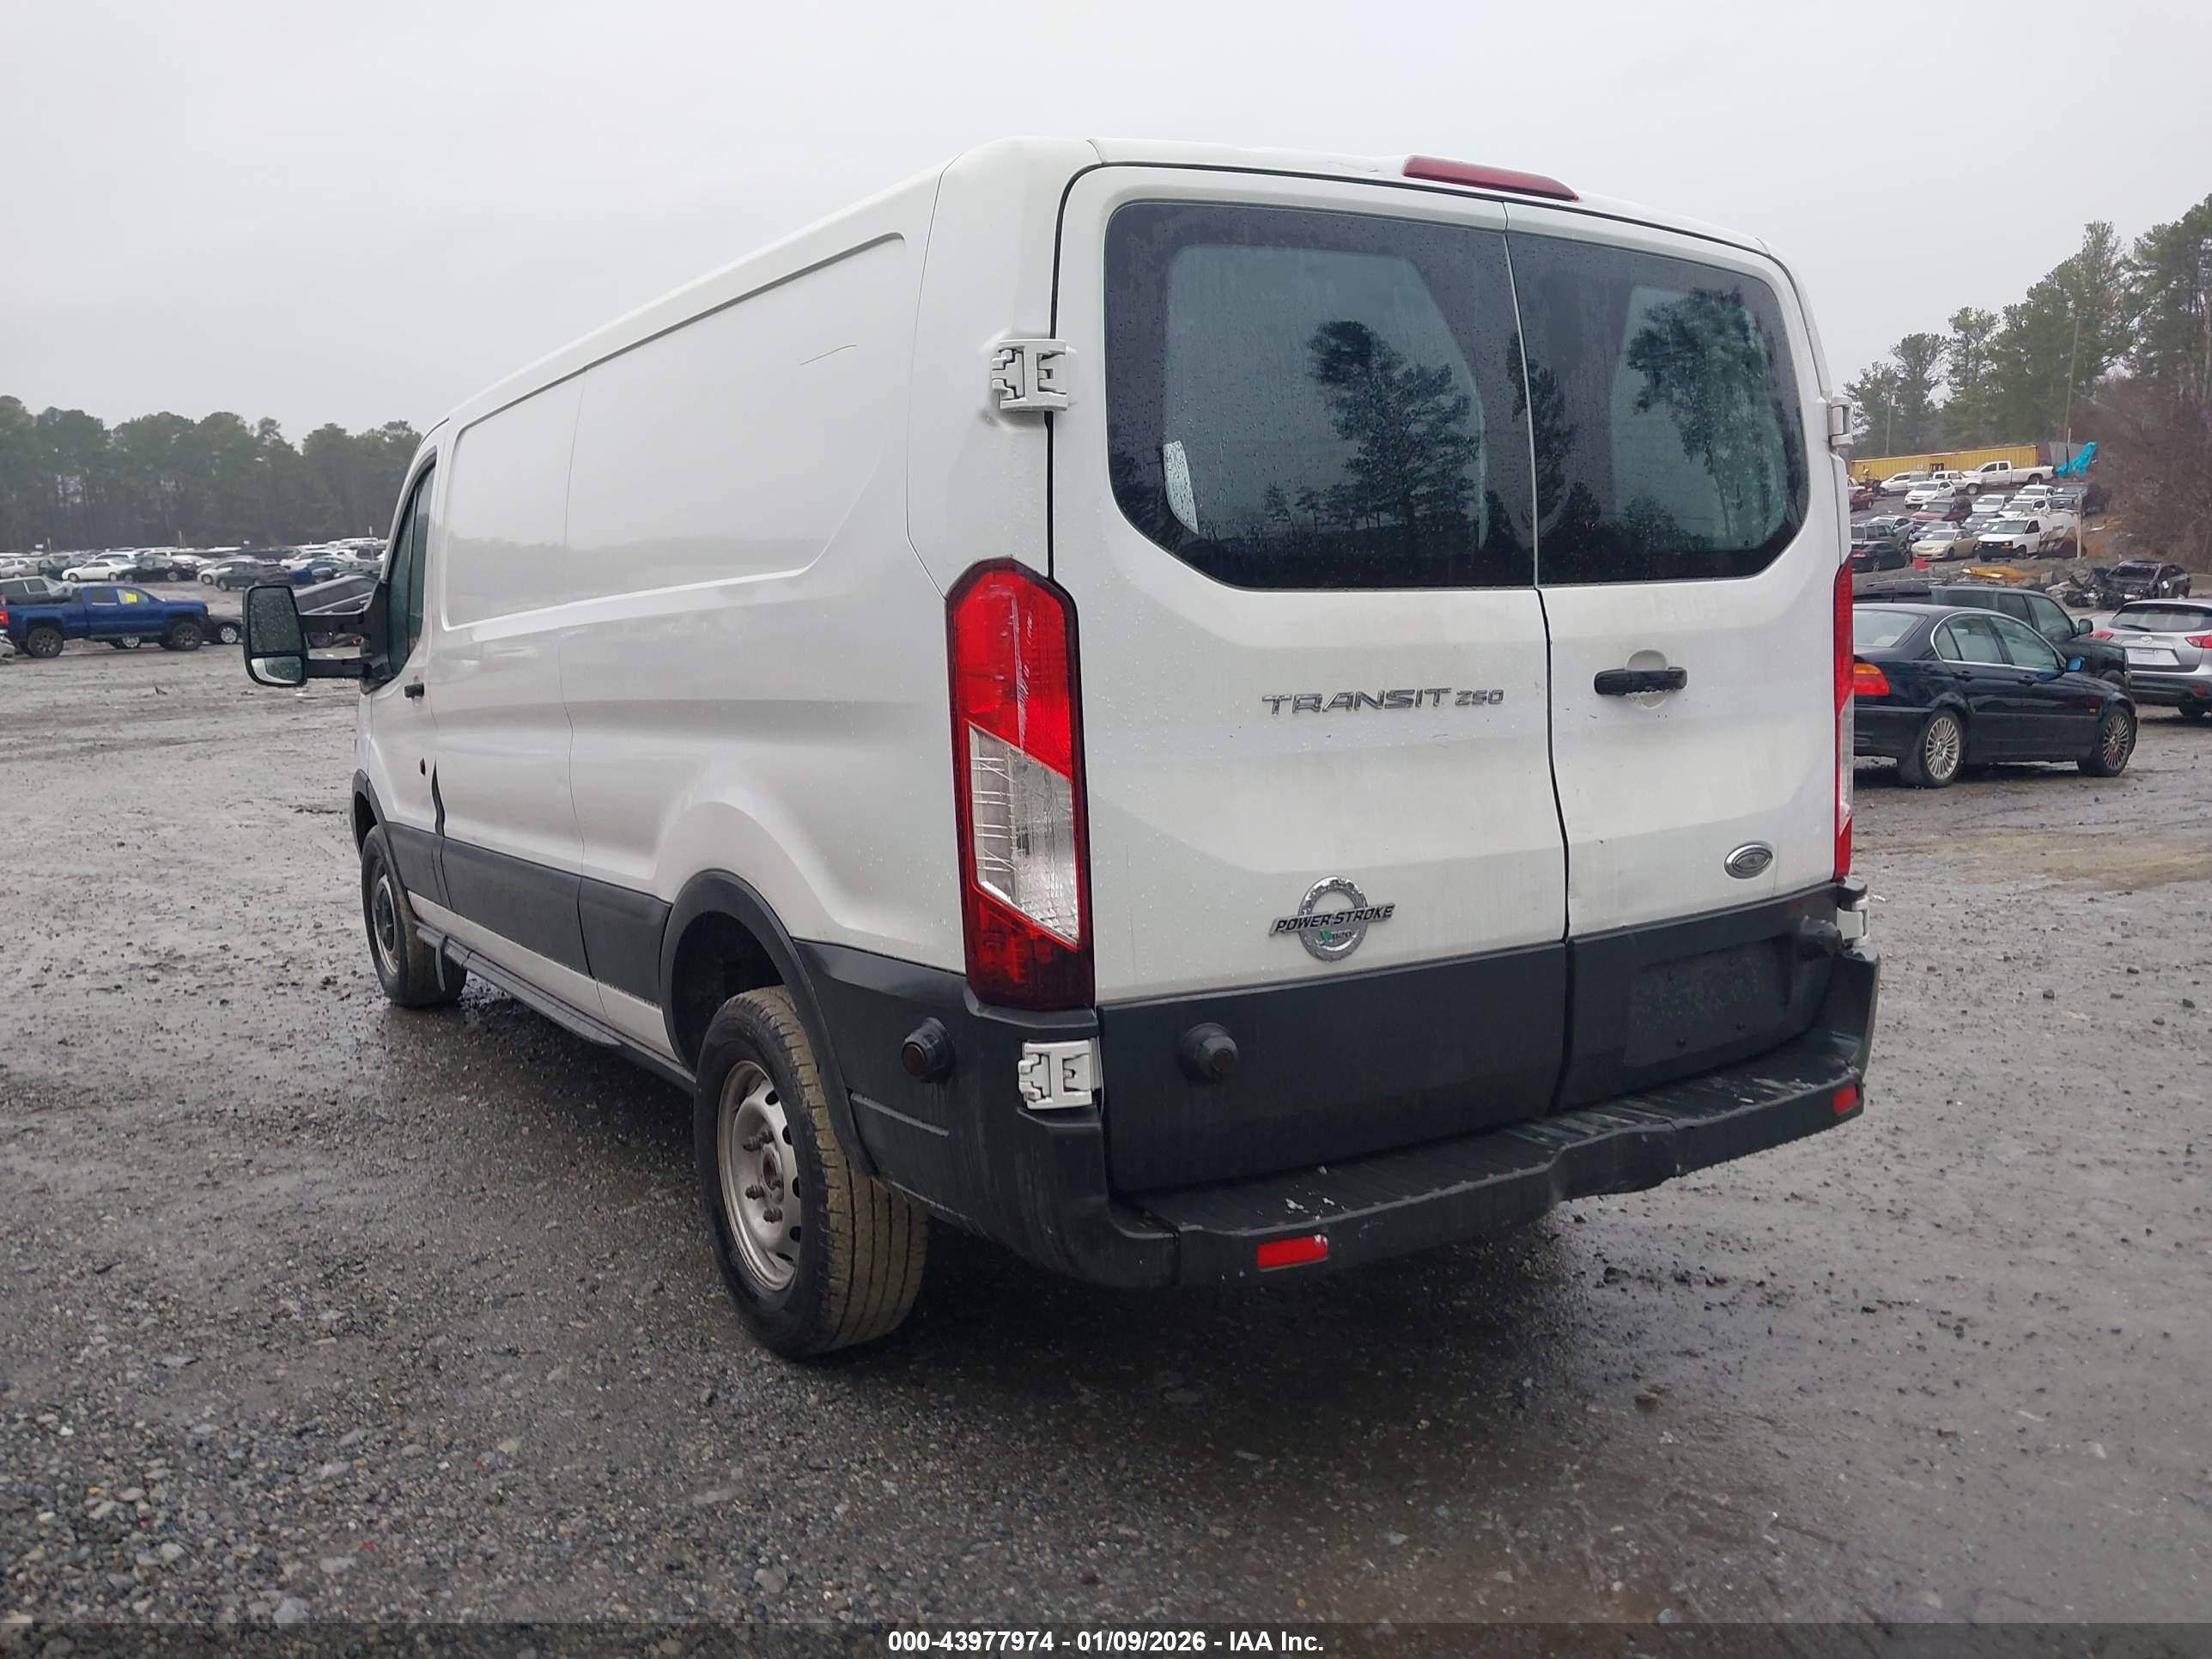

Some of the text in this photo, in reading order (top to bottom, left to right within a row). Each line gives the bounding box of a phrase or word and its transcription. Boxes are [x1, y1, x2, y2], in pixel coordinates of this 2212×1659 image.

[1261, 687, 1504, 715] TRANSIT 250
[1274, 904, 1395, 933] POWER STROKE
